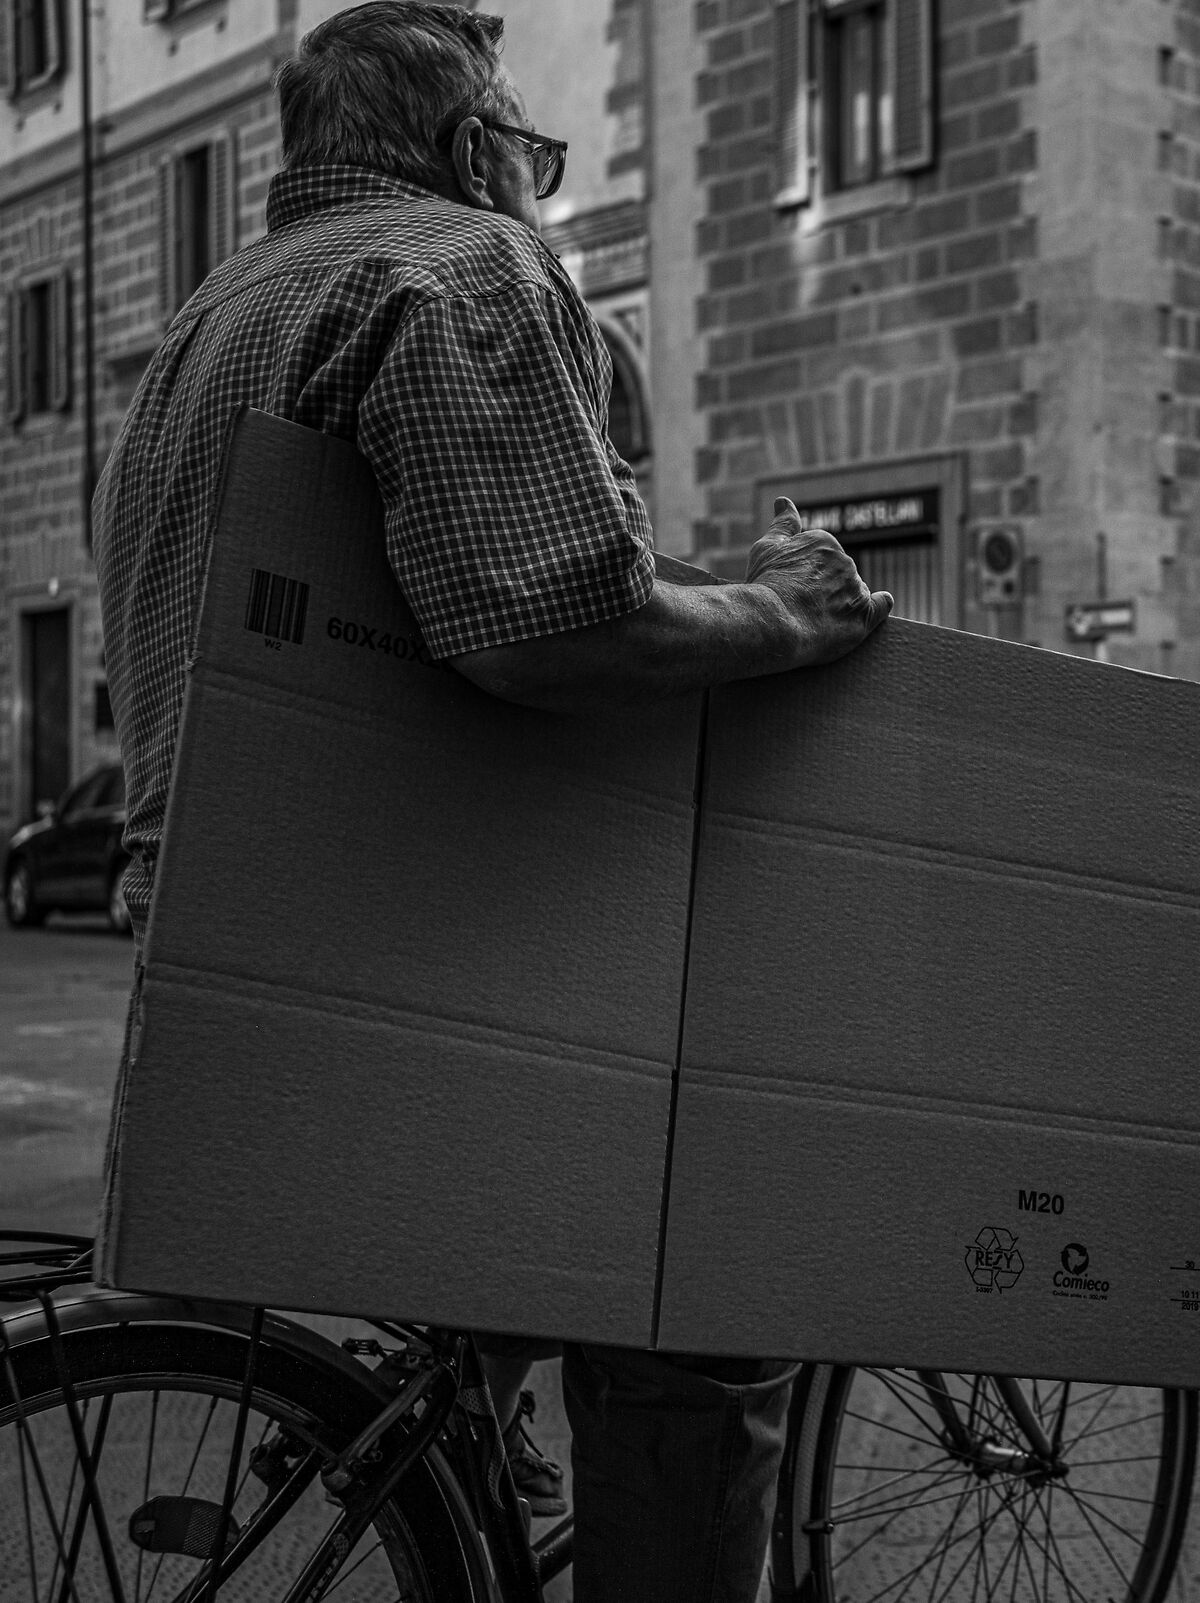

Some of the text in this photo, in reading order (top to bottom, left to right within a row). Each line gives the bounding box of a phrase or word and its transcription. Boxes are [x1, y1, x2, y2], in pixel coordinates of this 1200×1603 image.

[264, 638, 282, 651] W2
[1018, 1189, 1065, 1215] M20
[1053, 1270, 1110, 1293] Comieco
